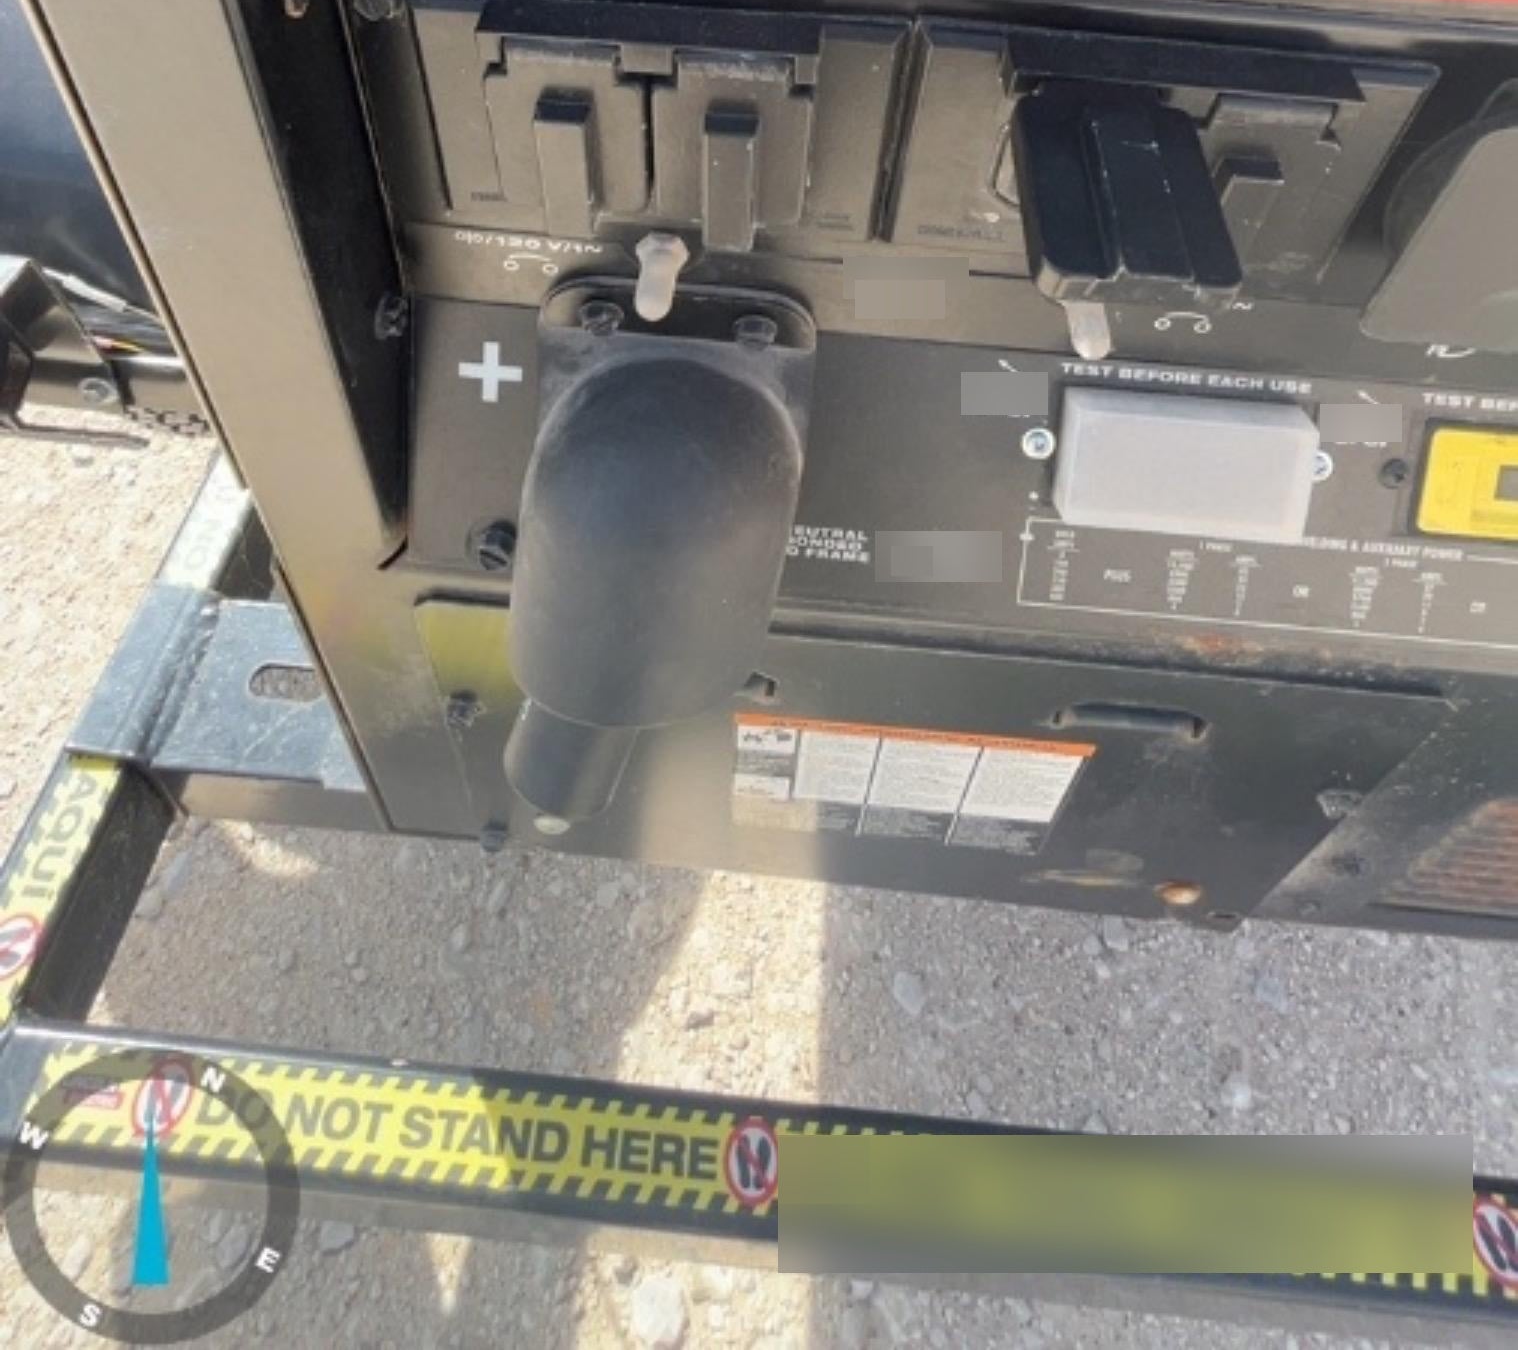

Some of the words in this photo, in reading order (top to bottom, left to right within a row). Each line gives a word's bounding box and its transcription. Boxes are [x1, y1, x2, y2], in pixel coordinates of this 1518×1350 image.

[1061, 362, 1114, 379] TEST
[1118, 367, 1202, 386] BEFORE
[1208, 373, 1265, 390] EACH
[1269, 378, 1312, 395] USE
[1422, 392, 1475, 409] TEST
[196, 1090, 277, 1132] DO
[283, 1092, 392, 1145] NOT
[399, 1105, 571, 1165] STAND
[581, 1129, 720, 1182] HERE
